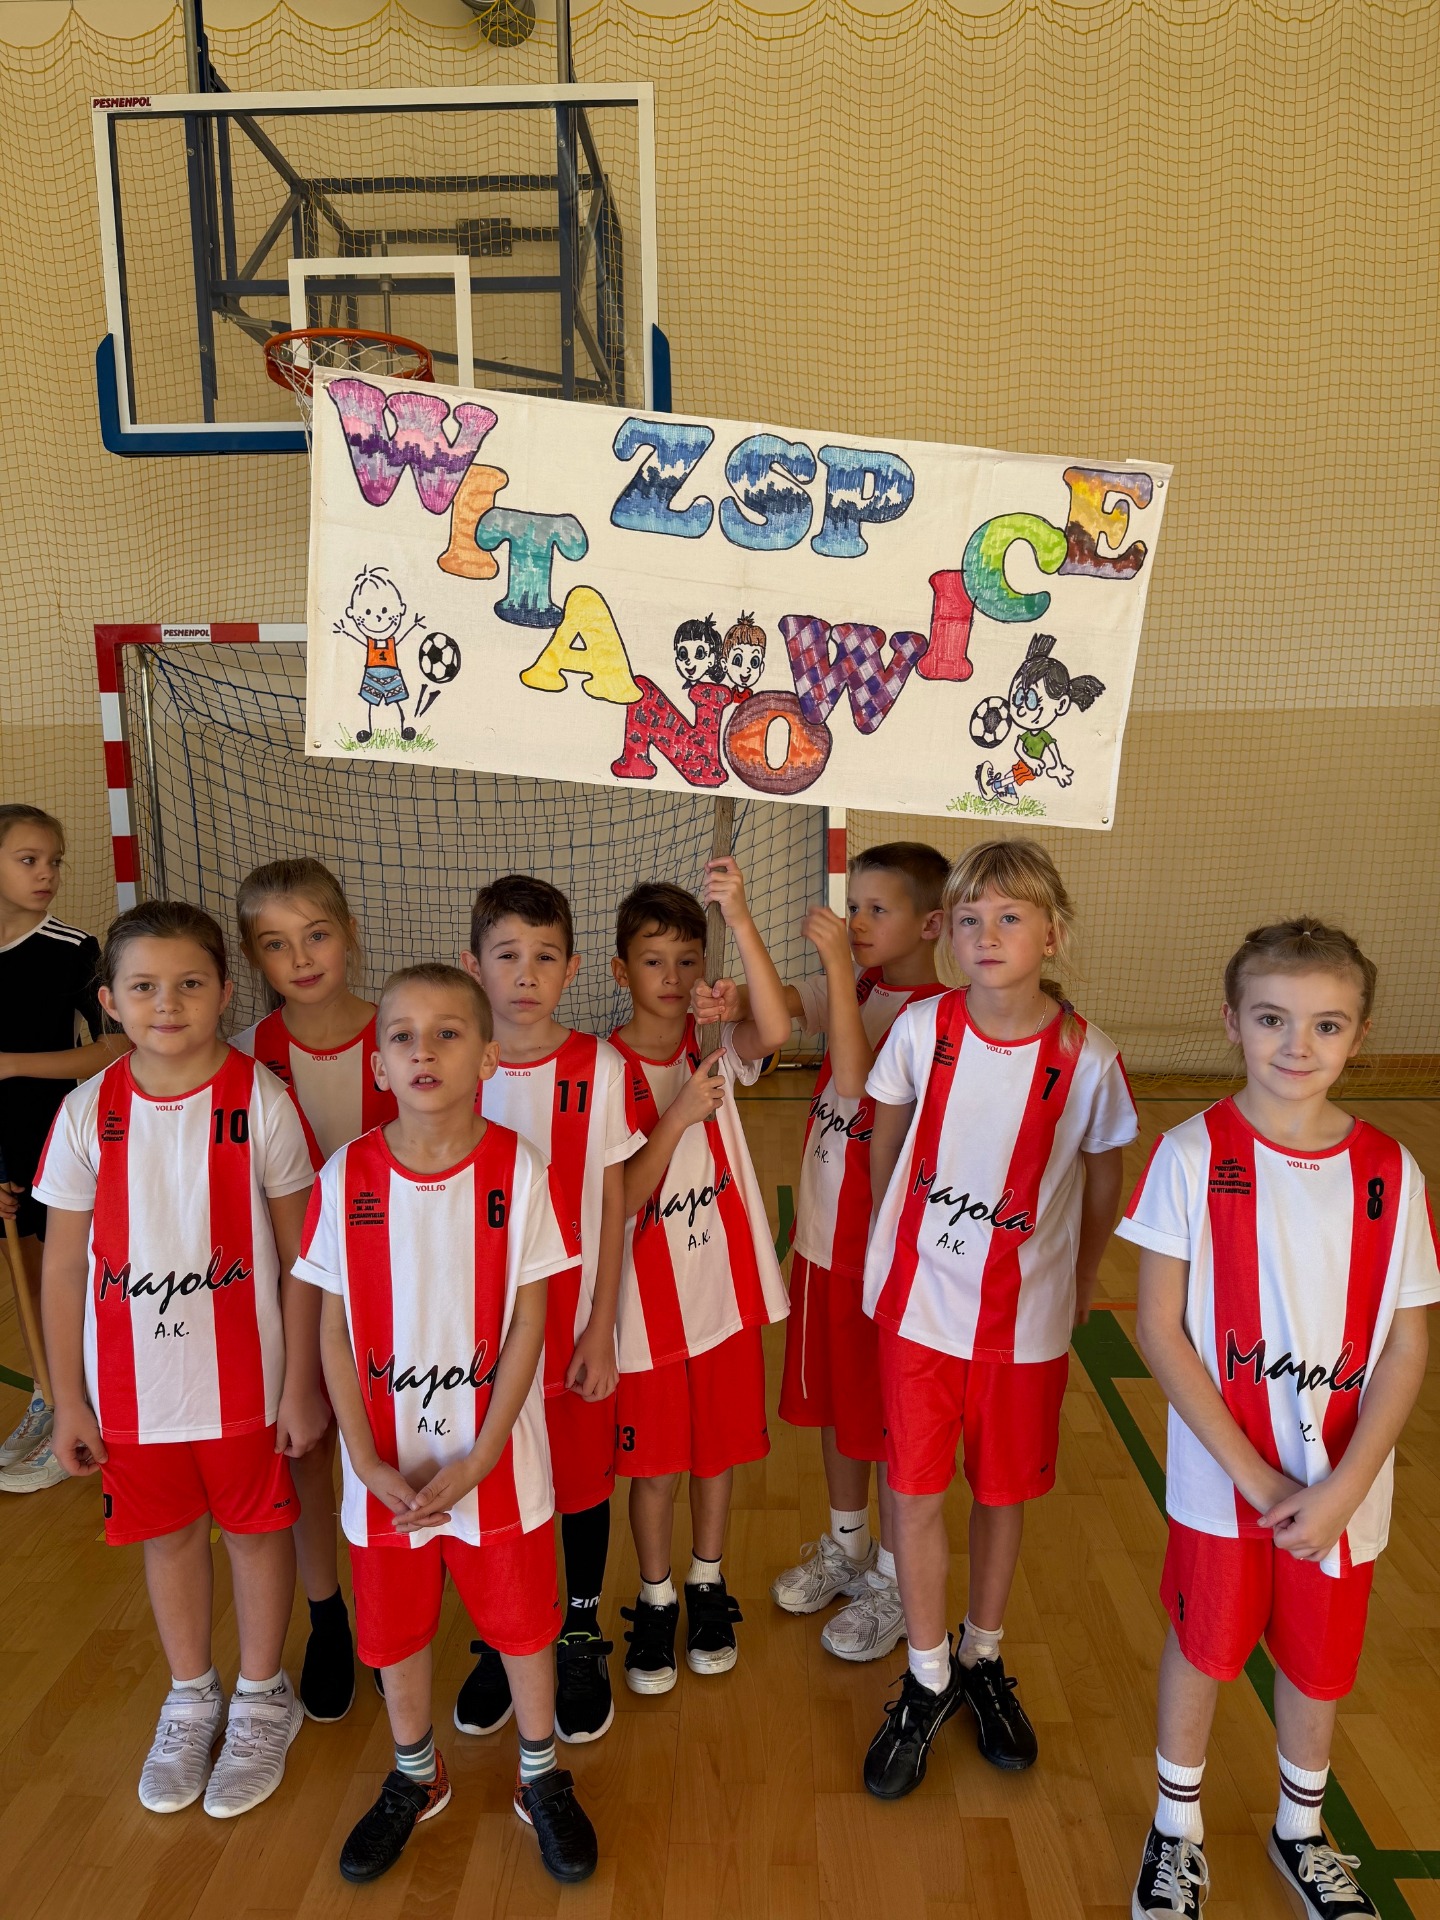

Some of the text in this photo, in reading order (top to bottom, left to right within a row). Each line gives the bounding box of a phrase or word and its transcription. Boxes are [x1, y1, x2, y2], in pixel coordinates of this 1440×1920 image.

[93, 97, 151, 108] PESMENPOL
[610, 417, 915, 558] ZSP
[163, 629, 210, 637] PESMENPOL
[557, 1079, 588, 1113] 11
[1042, 1066, 1061, 1101] 7
[214, 1108, 249, 1144] 10
[487, 1189, 505, 1228] 6
[1367, 1177, 1384, 1221] 8
[936, 1232, 965, 1256] A.K.
[154, 1321, 190, 1339] A.K.
[417, 1416, 451, 1436] A.K.
